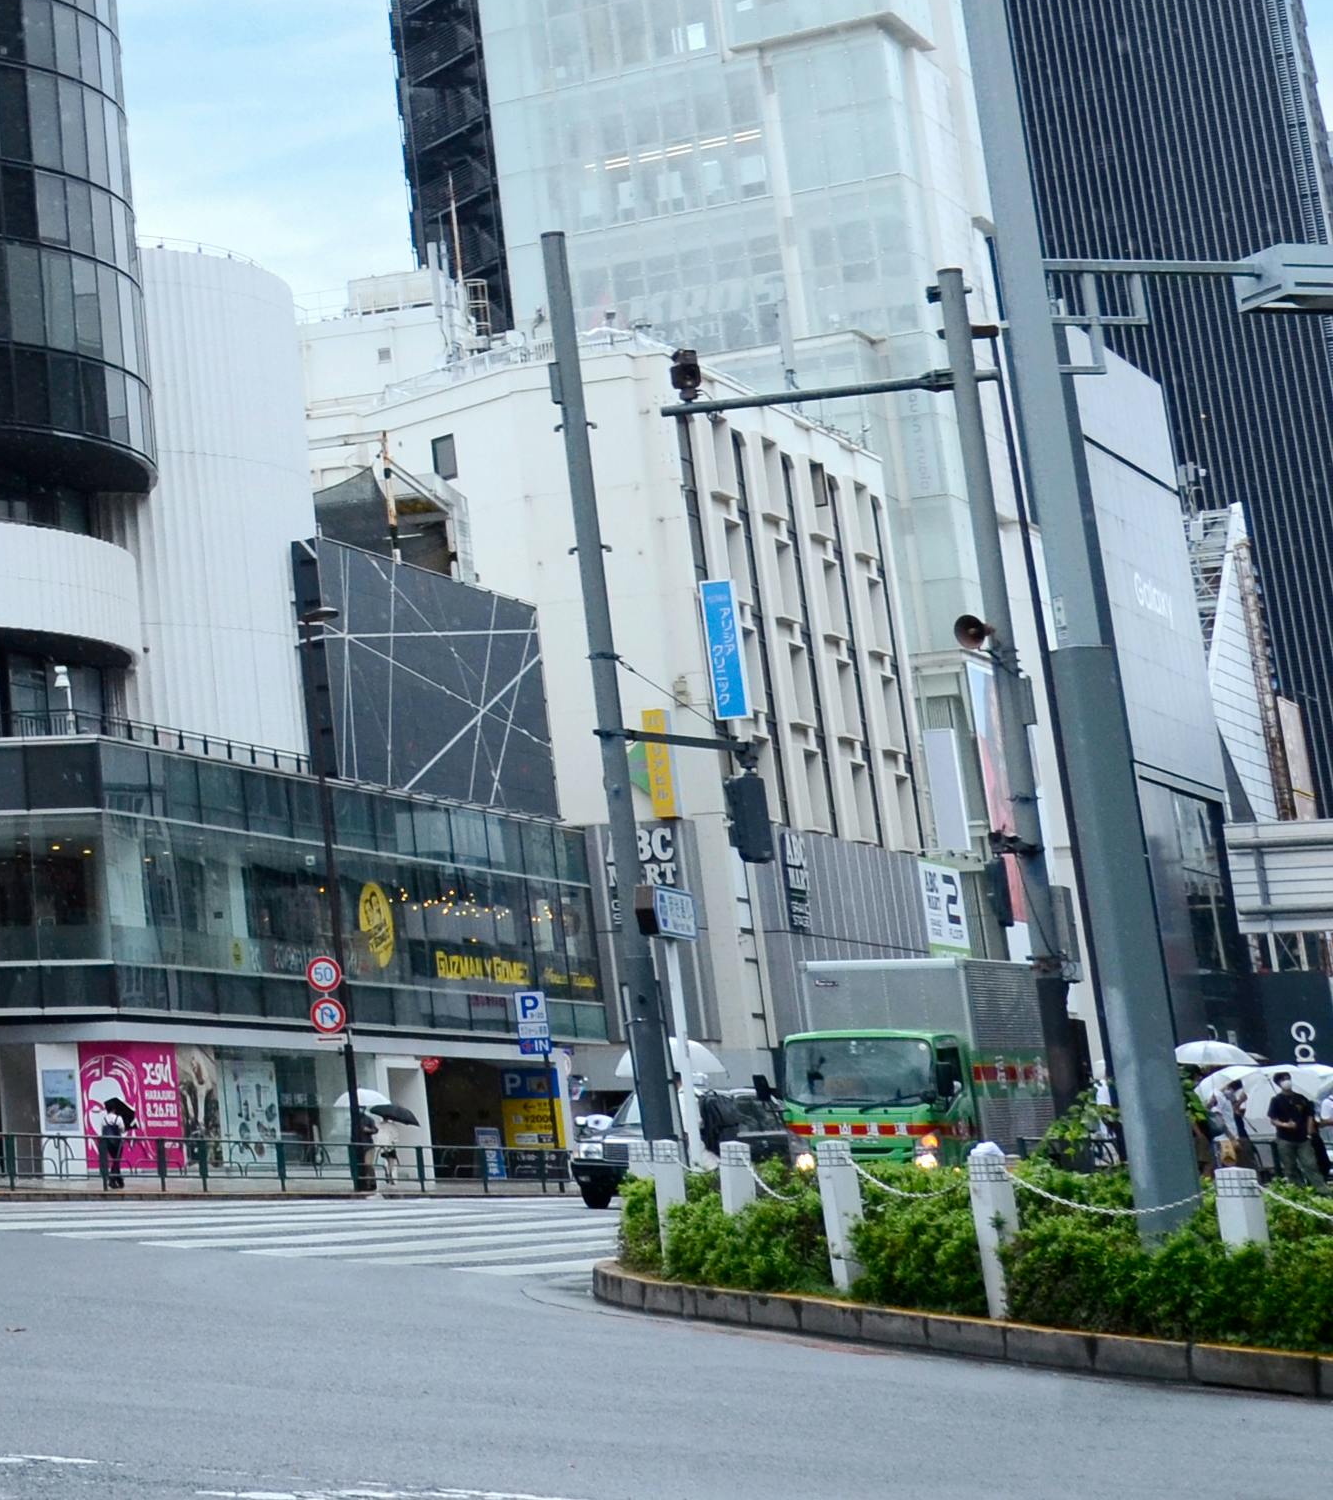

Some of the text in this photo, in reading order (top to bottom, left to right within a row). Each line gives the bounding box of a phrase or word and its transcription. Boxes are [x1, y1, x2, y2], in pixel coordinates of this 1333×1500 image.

[1134, 572, 1174, 630] Galaxy
[635, 827, 674, 861] BC
[785, 833, 806, 867] ABC
[642, 862, 677, 886] RT
[941, 874, 962, 926] 2
[314, 967, 333, 982] 50
[436, 951, 483, 980] GUZMAN
[482, 959, 492, 984] Y
[520, 995, 539, 1019] P
[534, 1039, 550, 1052] IN
[504, 1073, 521, 1096] P
